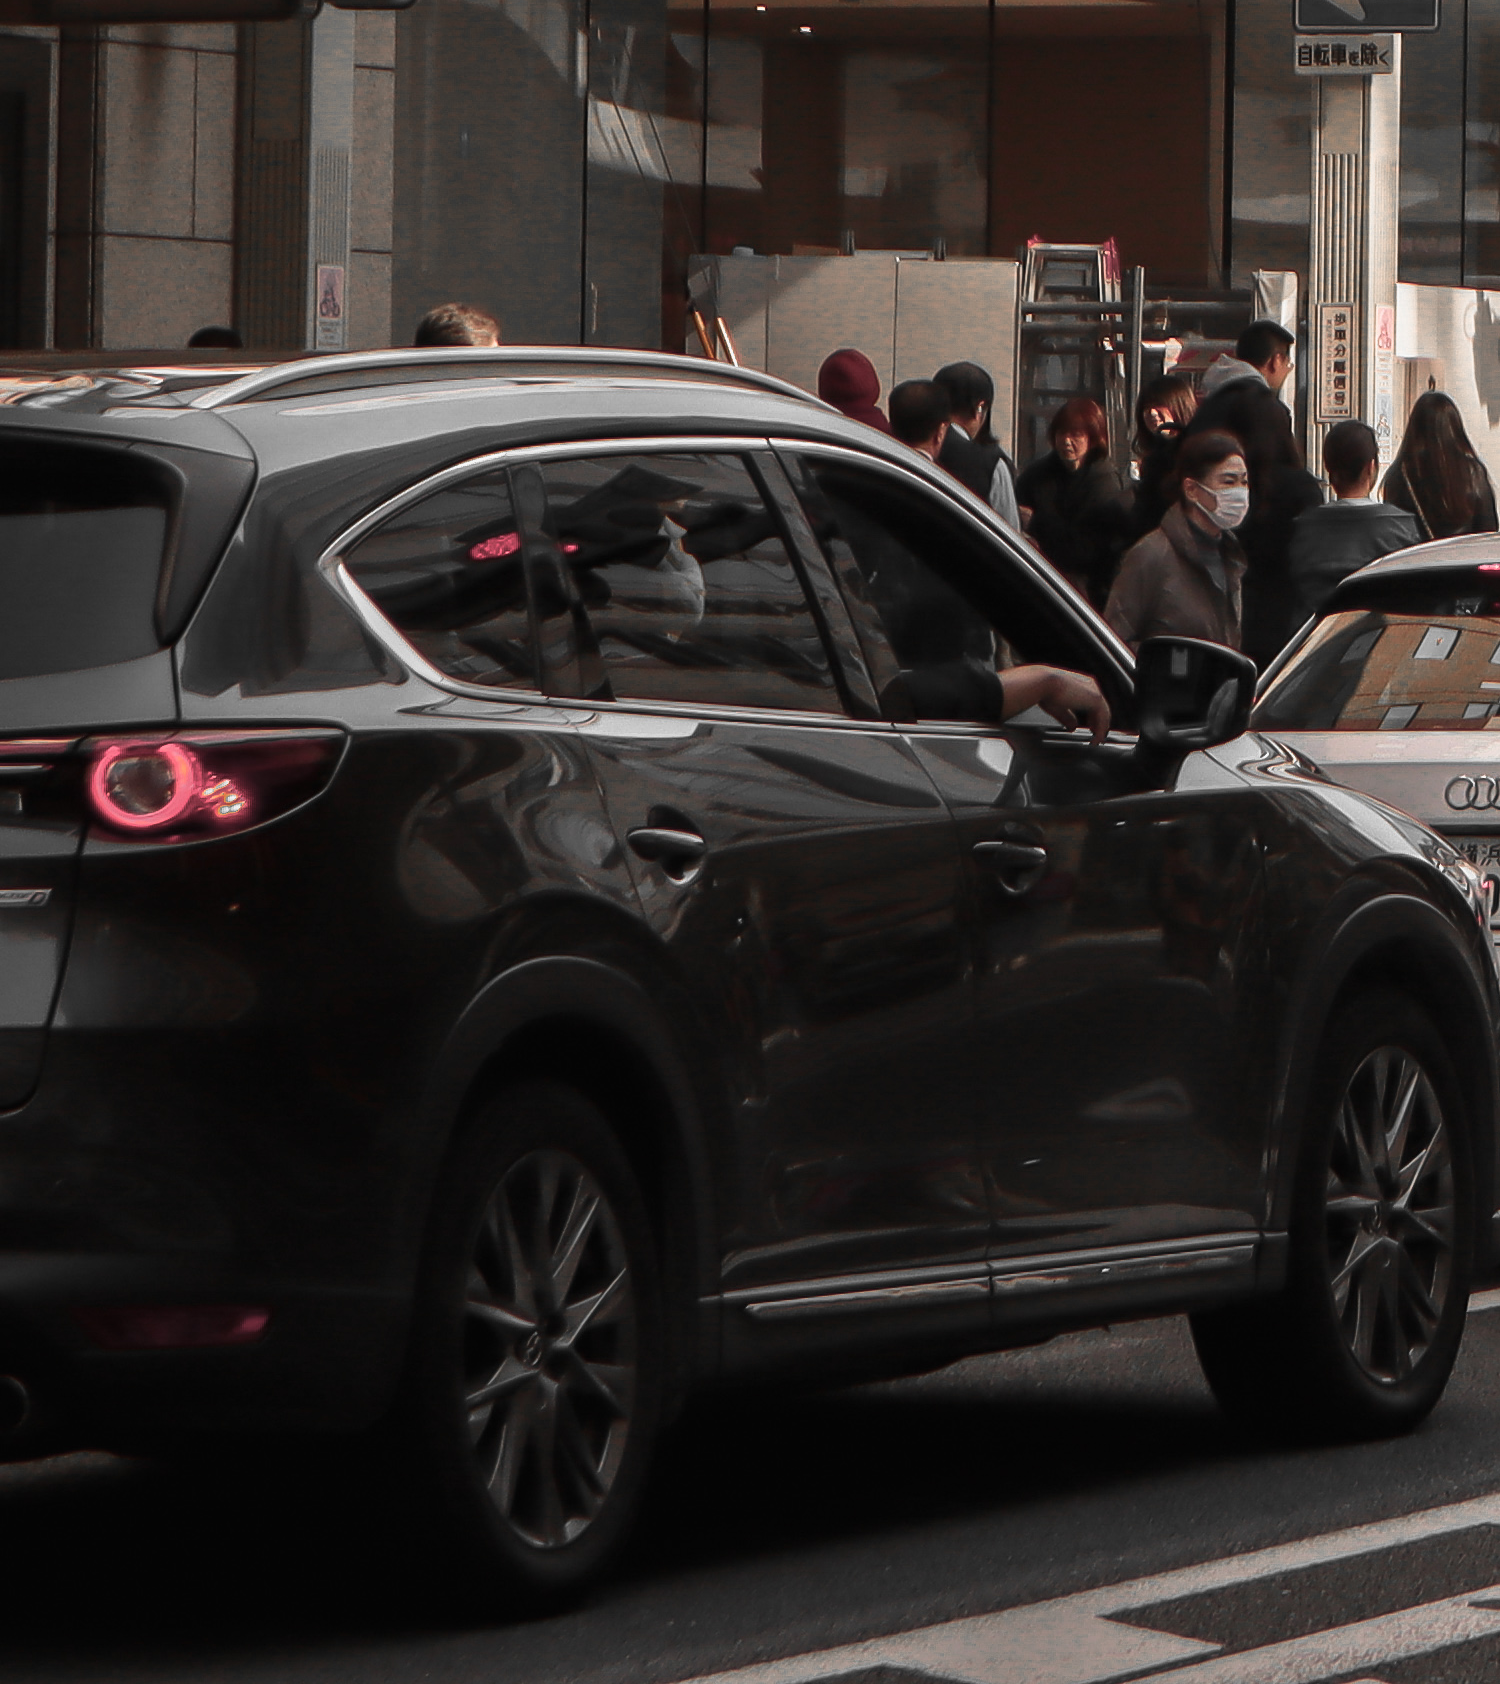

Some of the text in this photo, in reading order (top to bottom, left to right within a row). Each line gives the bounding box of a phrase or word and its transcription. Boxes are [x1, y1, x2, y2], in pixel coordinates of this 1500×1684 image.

[1297, 42, 1390, 67] 自転車を除く
